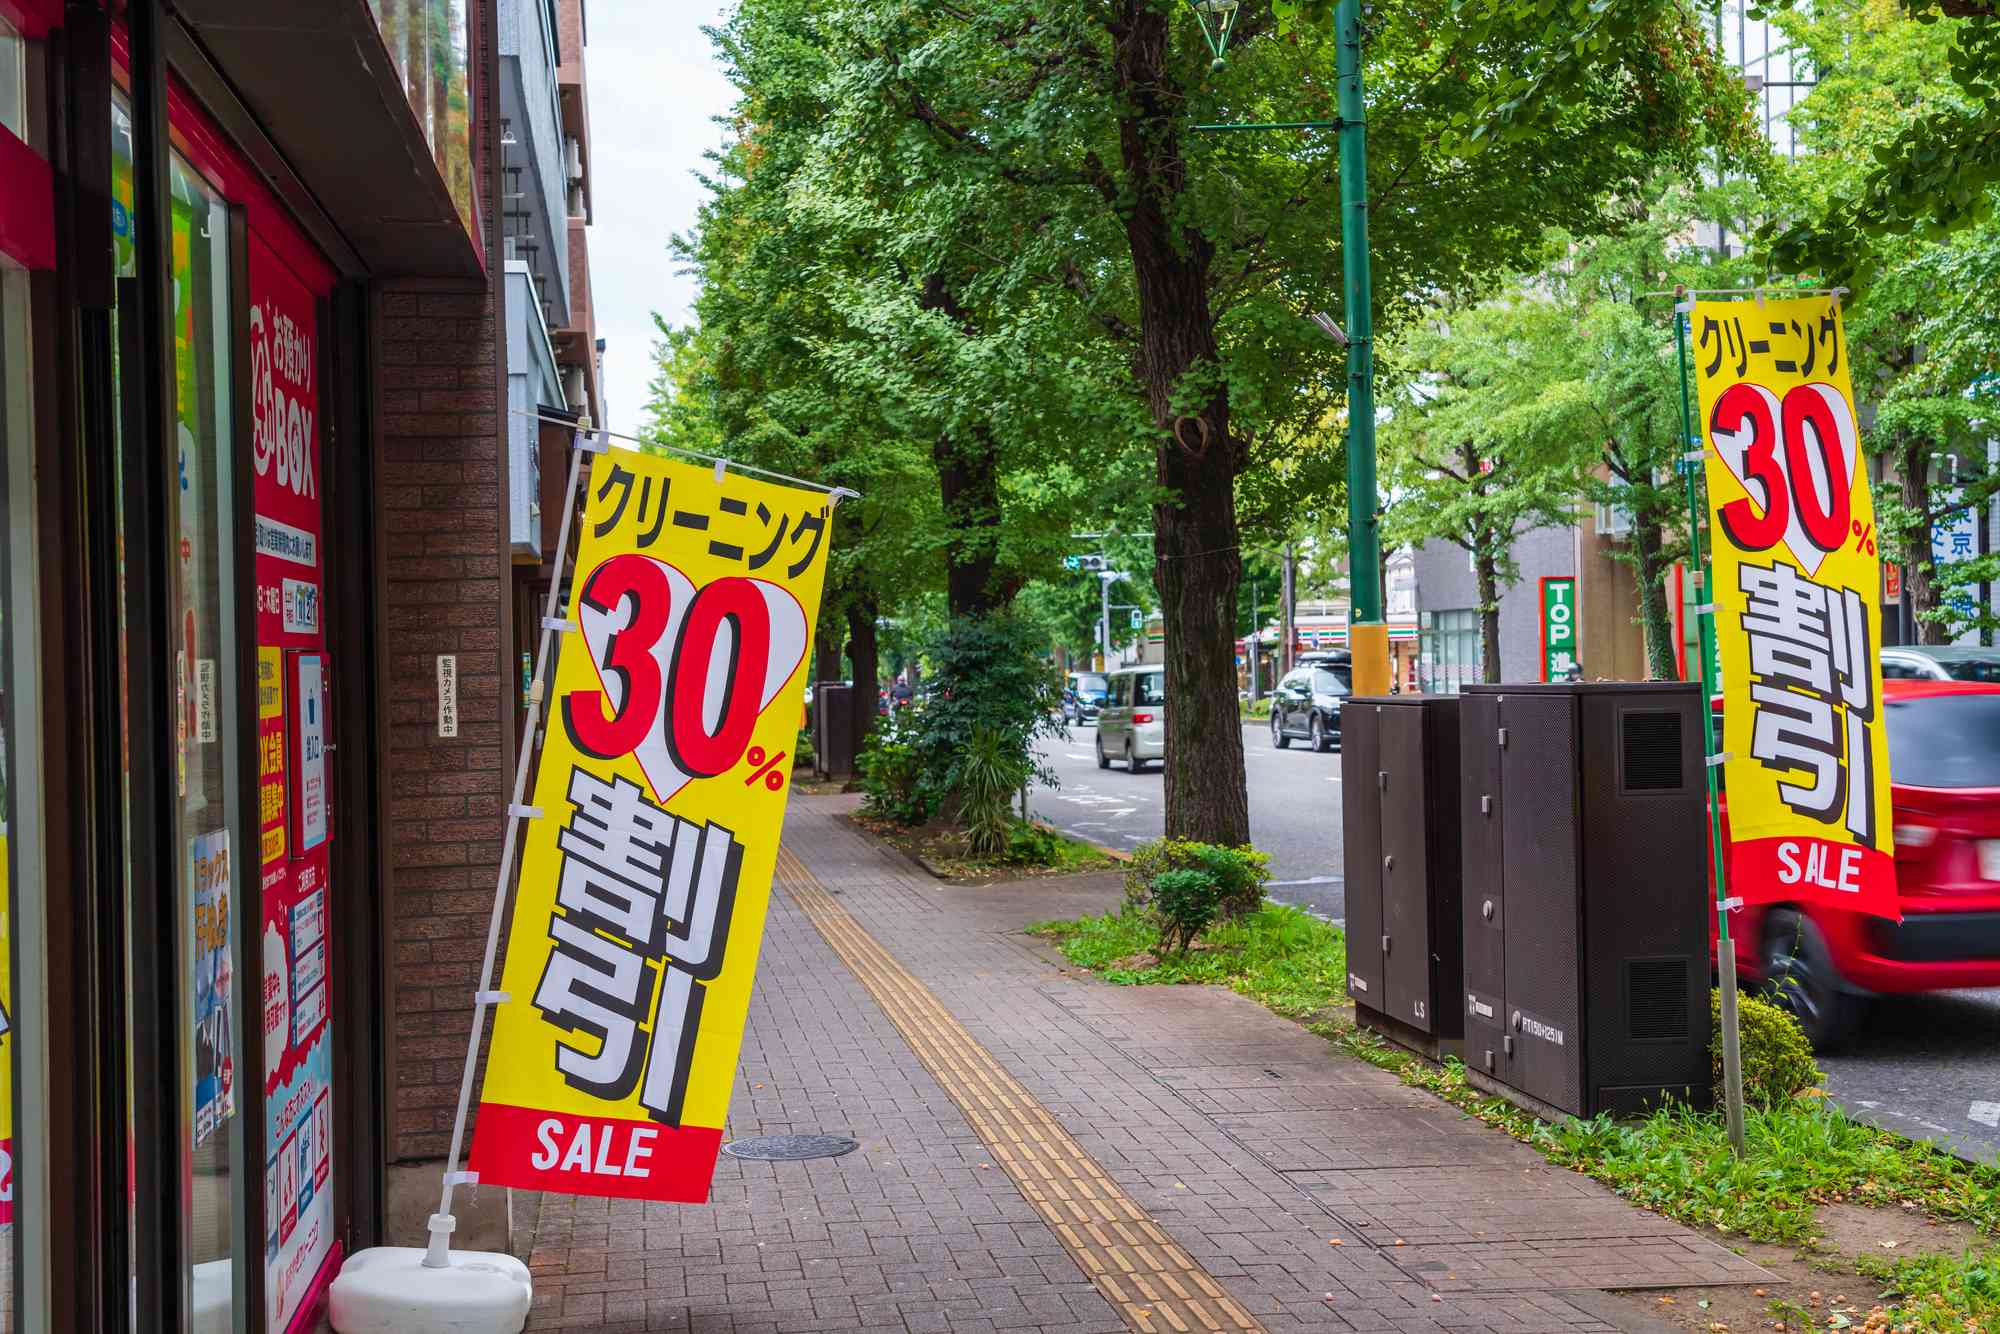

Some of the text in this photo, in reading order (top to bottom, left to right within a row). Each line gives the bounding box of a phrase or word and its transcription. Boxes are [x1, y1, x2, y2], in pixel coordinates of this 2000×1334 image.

[1700, 306, 1838, 378] クリーニング
[275, 388, 316, 500] BOX
[594, 463, 830, 579] クリーニング
[1738, 560, 1877, 851] 割引
[1777, 841, 1862, 893] SALE
[532, 764, 745, 1129] 割引
[531, 1118, 658, 1178] SALE
